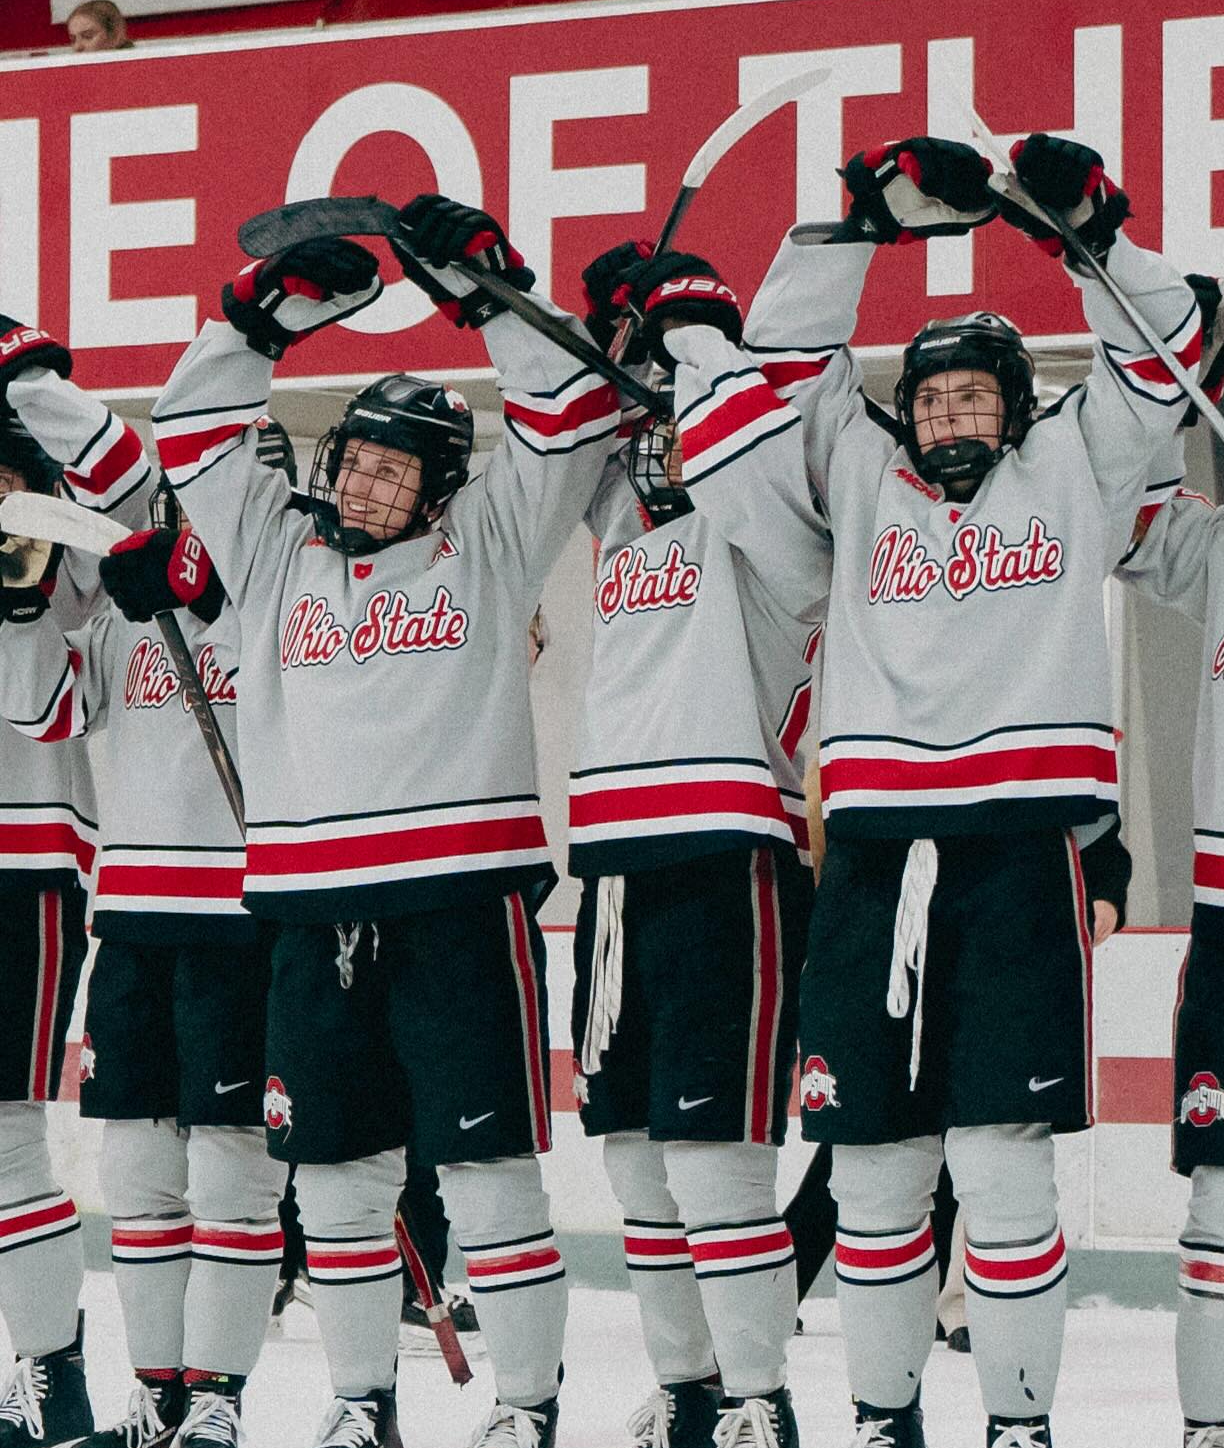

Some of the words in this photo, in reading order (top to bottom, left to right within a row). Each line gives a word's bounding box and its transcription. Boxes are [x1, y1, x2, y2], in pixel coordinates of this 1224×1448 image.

[0, 104, 198, 350] E
[284, 64, 649, 334] OF
[597, 539, 702, 624] State
[867, 523, 942, 605] Ohio
[943, 515, 1065, 601] State
[279, 592, 349, 671] Ohio
[351, 585, 468, 664] State
[123, 637, 182, 711] Ohio
